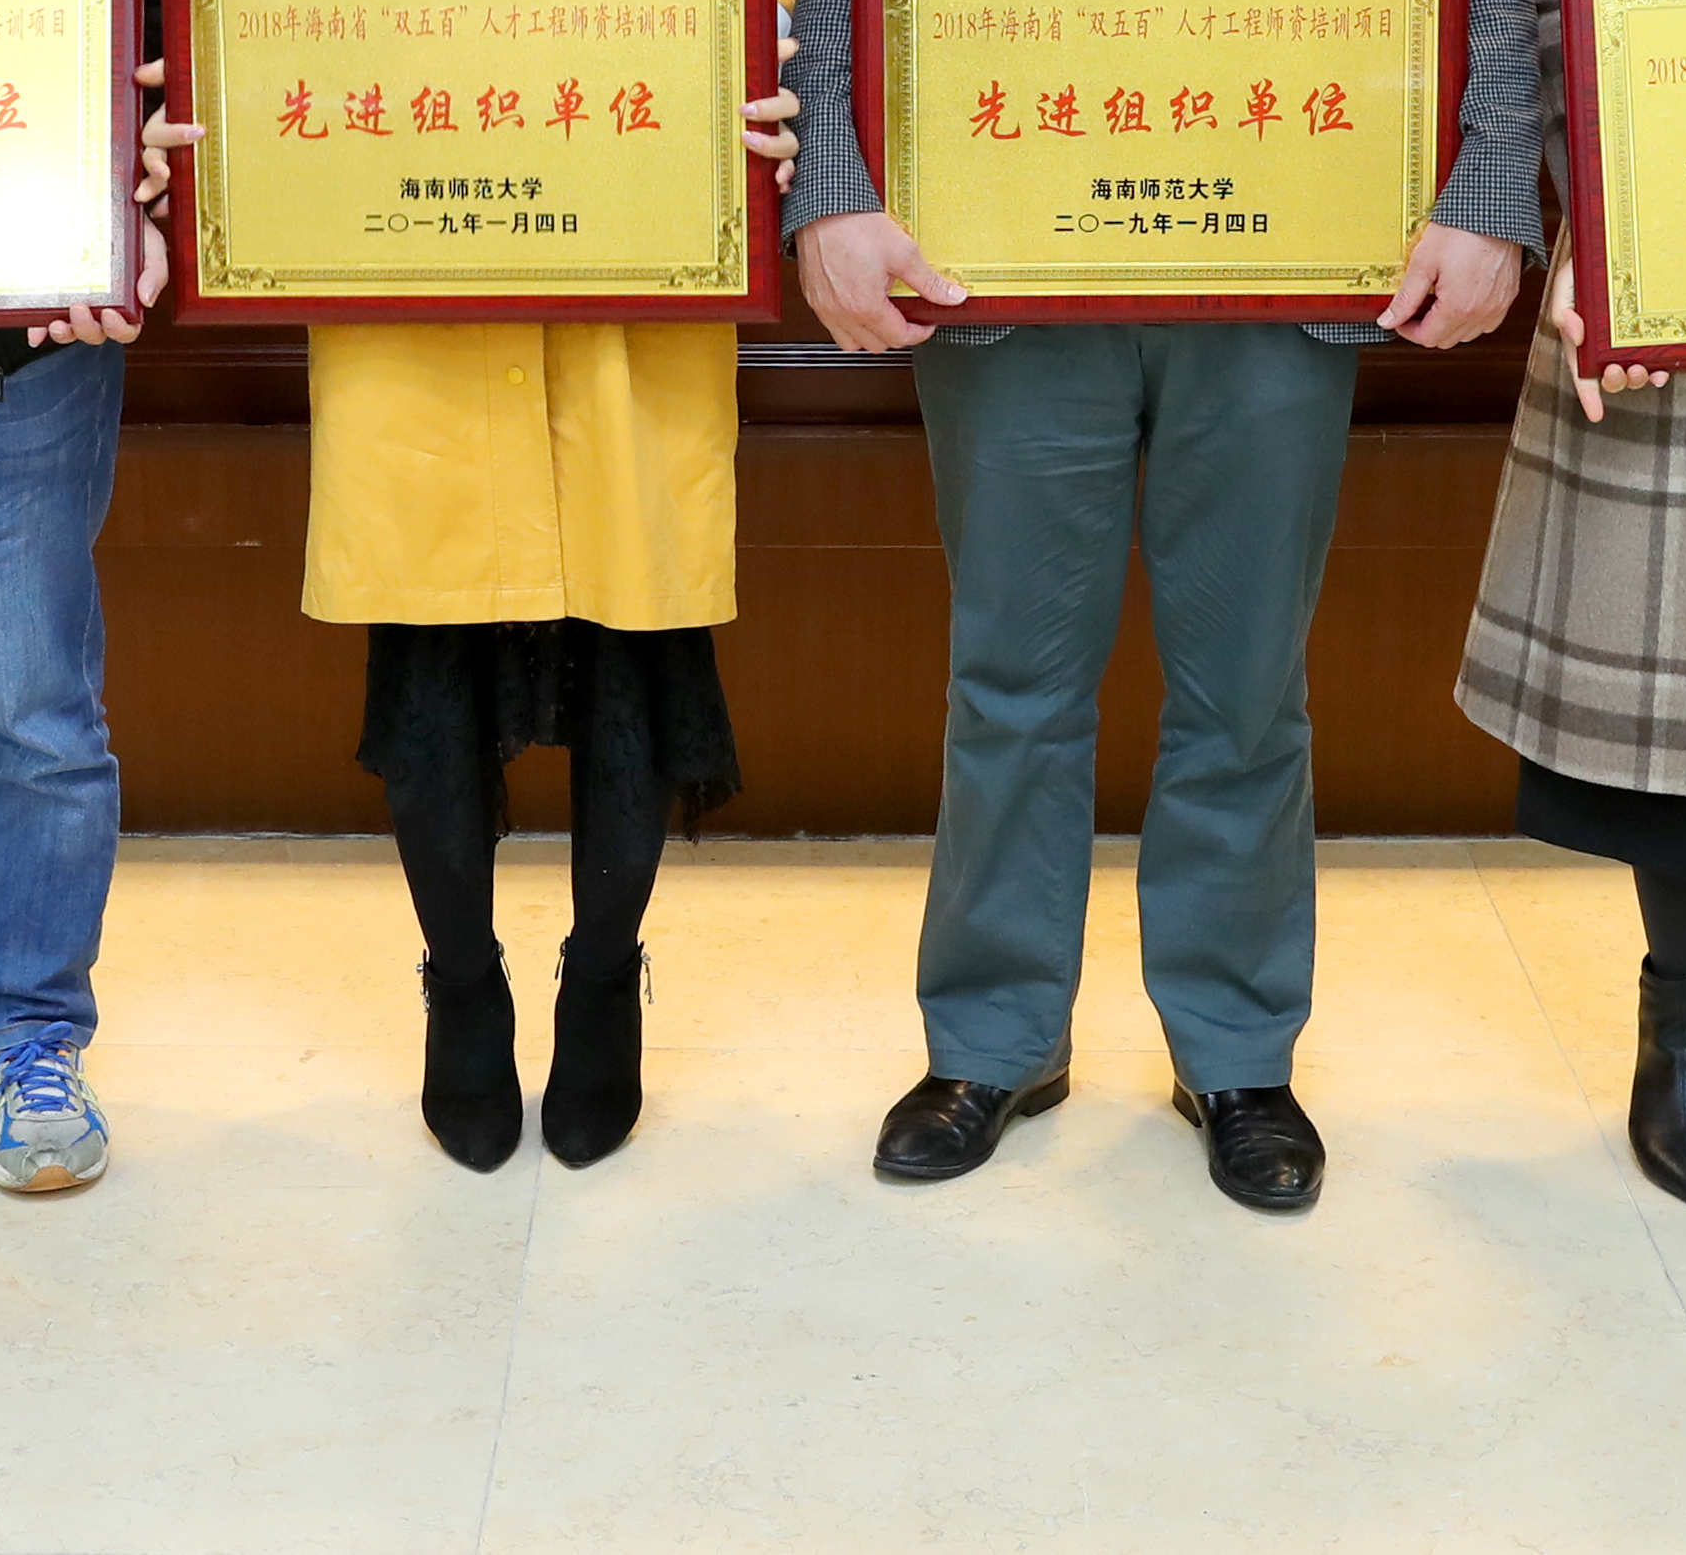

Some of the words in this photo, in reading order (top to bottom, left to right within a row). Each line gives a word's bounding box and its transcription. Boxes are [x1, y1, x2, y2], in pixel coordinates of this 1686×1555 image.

[276, 77, 662, 142] 先进组织单位
[968, 77, 1354, 142] 先进组织单位
[399, 176, 543, 201] 海南师范大学
[1091, 176, 1234, 201] 海南师范大学
